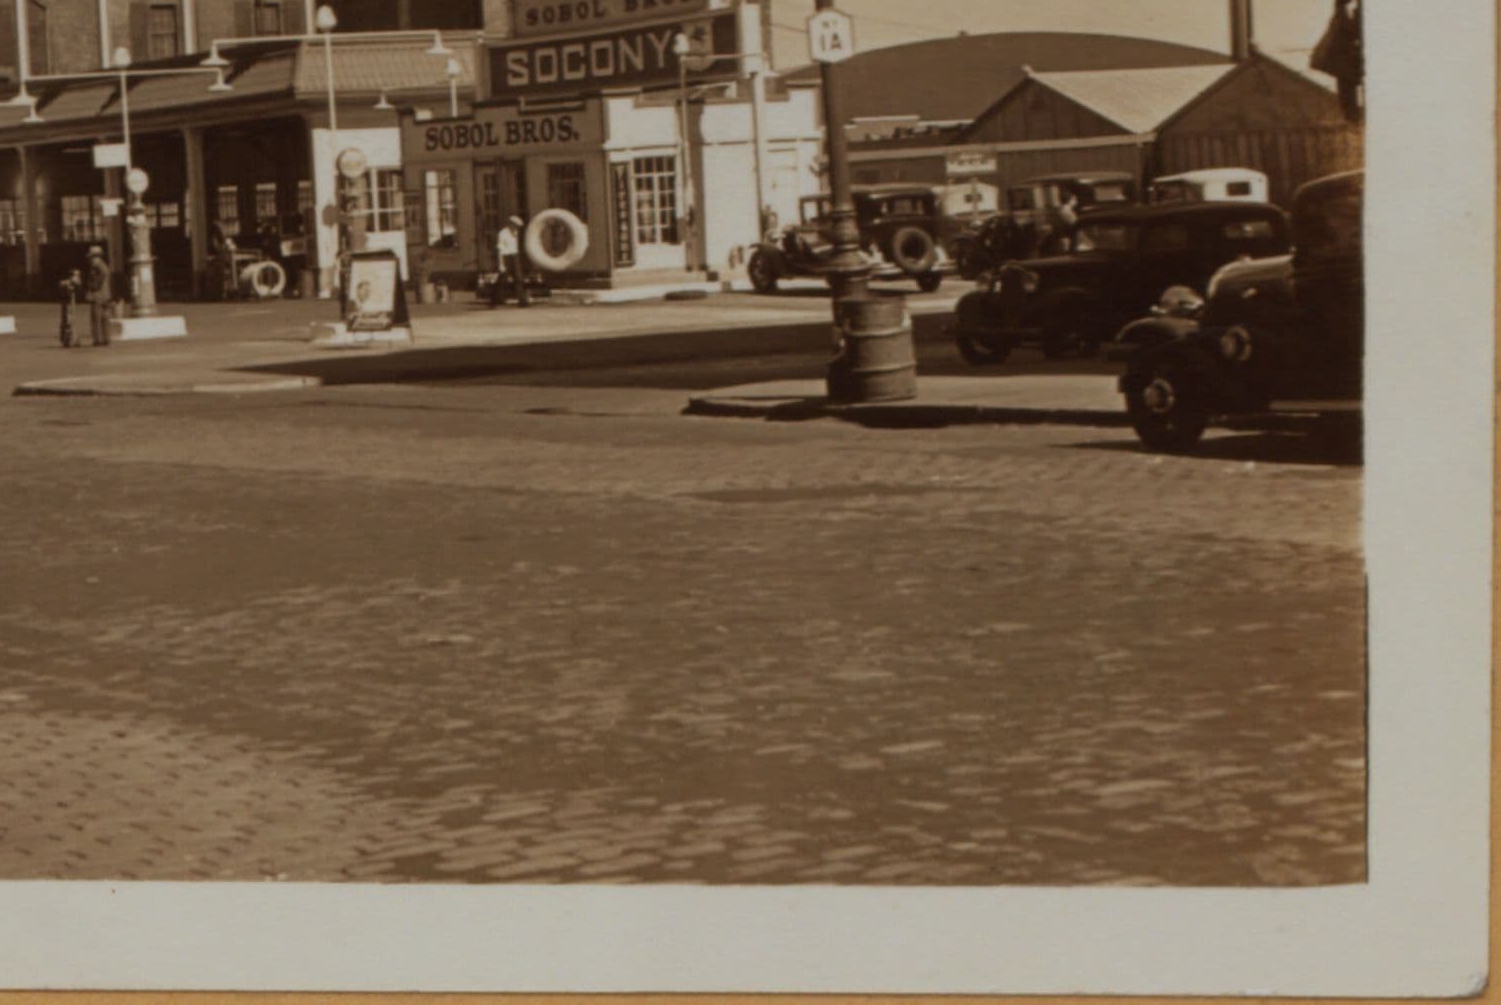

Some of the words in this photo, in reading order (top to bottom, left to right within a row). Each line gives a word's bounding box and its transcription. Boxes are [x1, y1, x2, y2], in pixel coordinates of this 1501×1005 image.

[526, 0, 605, 26] SOBOL
[506, 28, 673, 86] SOCONY
[820, 32, 843, 51] 1A
[425, 122, 499, 151] SOBOL
[505, 115, 581, 145] BROS.
